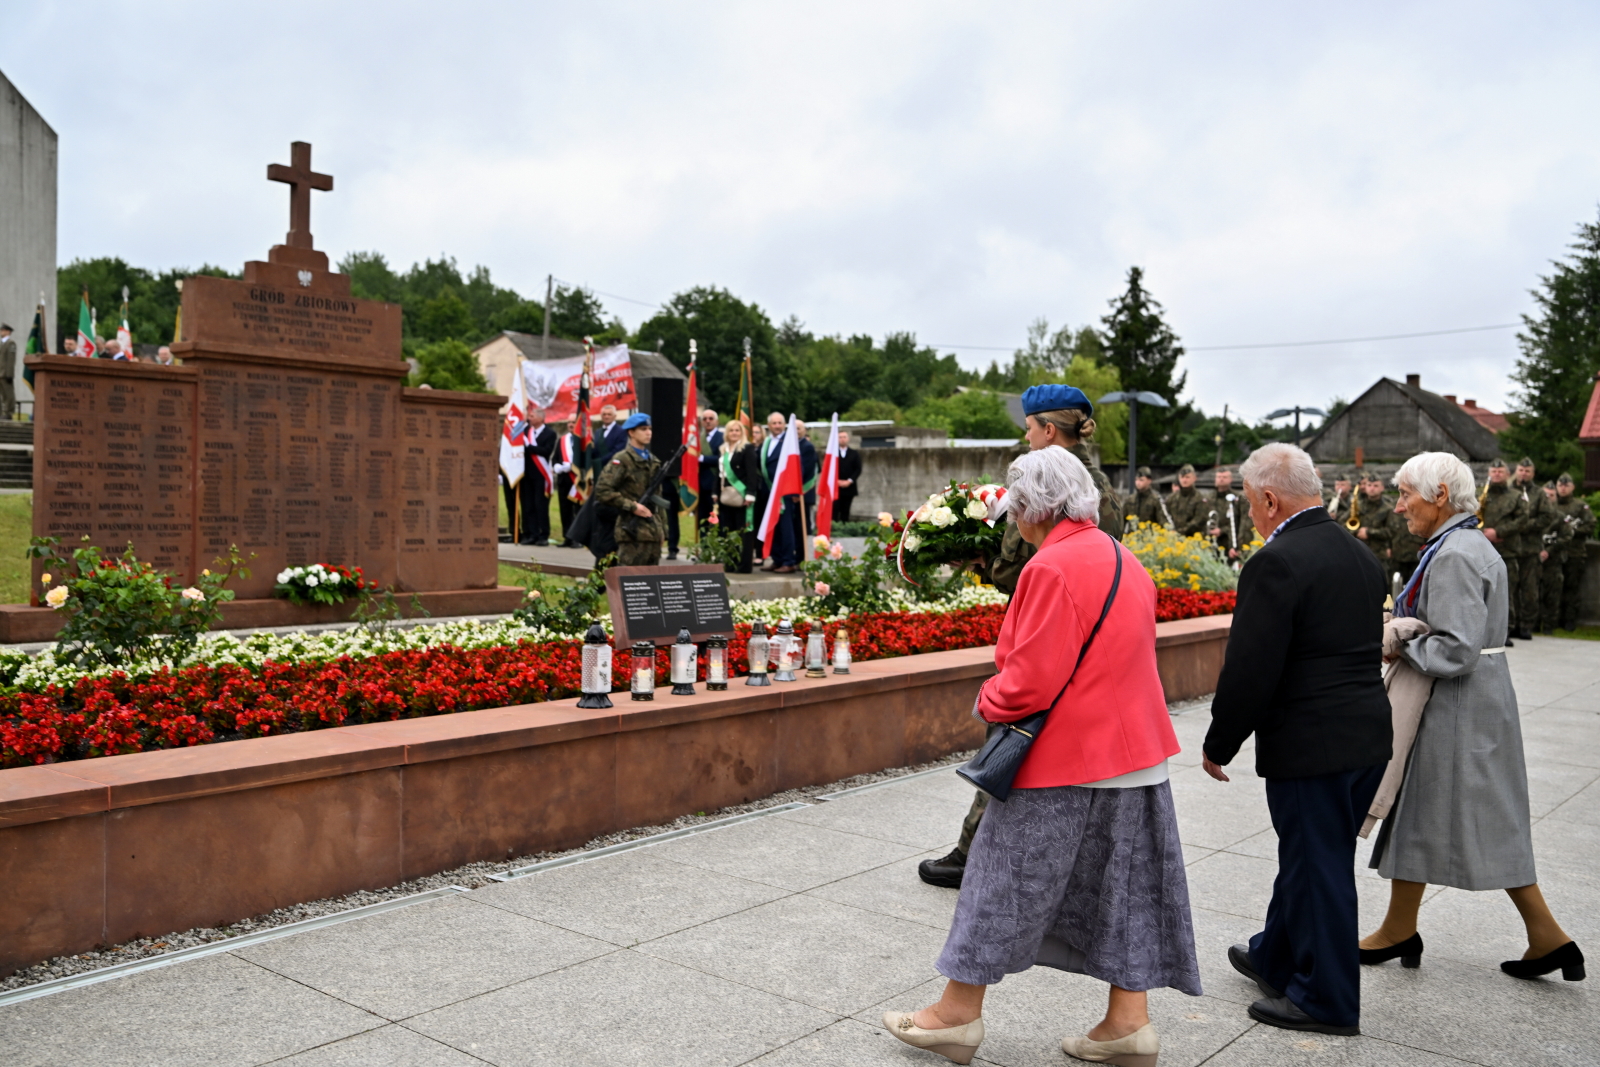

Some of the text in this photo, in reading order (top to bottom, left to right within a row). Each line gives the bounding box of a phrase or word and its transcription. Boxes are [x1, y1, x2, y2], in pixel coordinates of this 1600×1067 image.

[250, 288, 358, 315] GRÓB ZBIOROWY
[570, 380, 628, 402] SSZÓW
